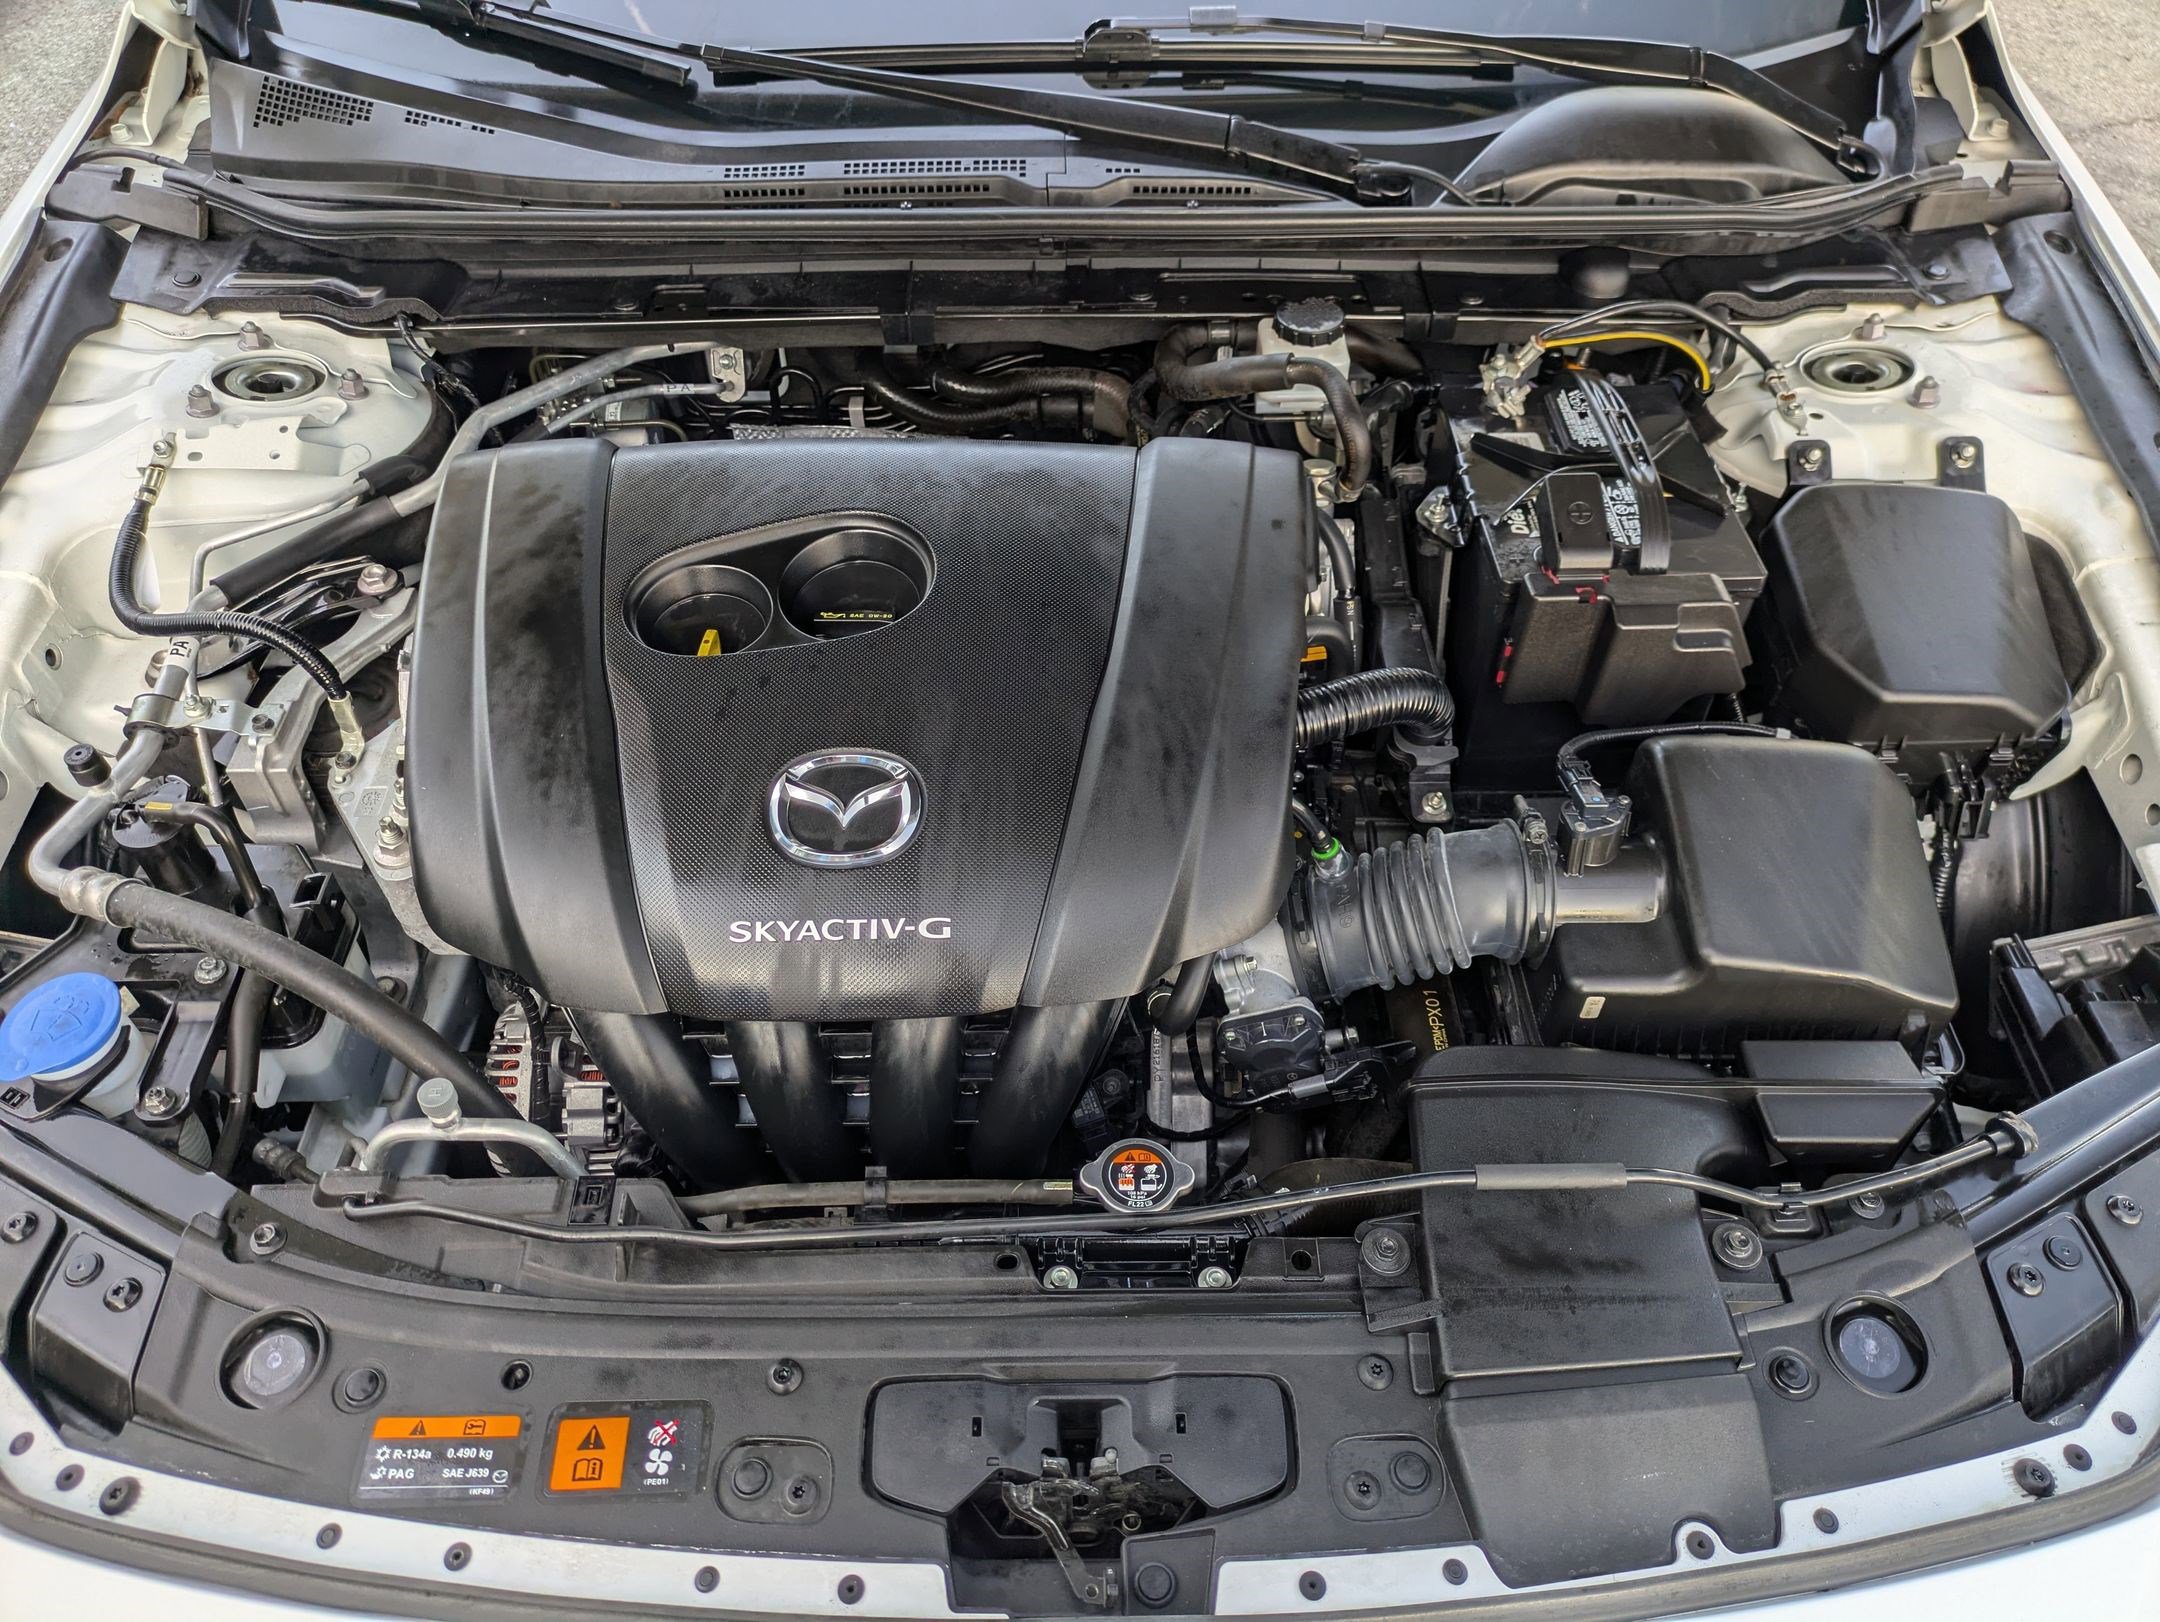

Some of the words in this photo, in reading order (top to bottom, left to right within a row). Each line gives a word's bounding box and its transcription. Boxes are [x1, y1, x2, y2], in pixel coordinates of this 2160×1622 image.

[666, 383, 692, 393] PA
[170, 641, 190, 657] PA
[729, 917, 951, 943] SKYACTIV-G
[1423, 990, 1445, 1027] PX01
[392, 1449, 432, 1459] R-134a
[446, 1447, 477, 1459] 0.490
[479, 1447, 494, 1461] kg
[388, 1468, 415, 1480] PAG
[441, 1468, 464, 1478] SAE
[465, 1468, 490, 1478] J639
[643, 1477, 669, 1486] (PE01)
